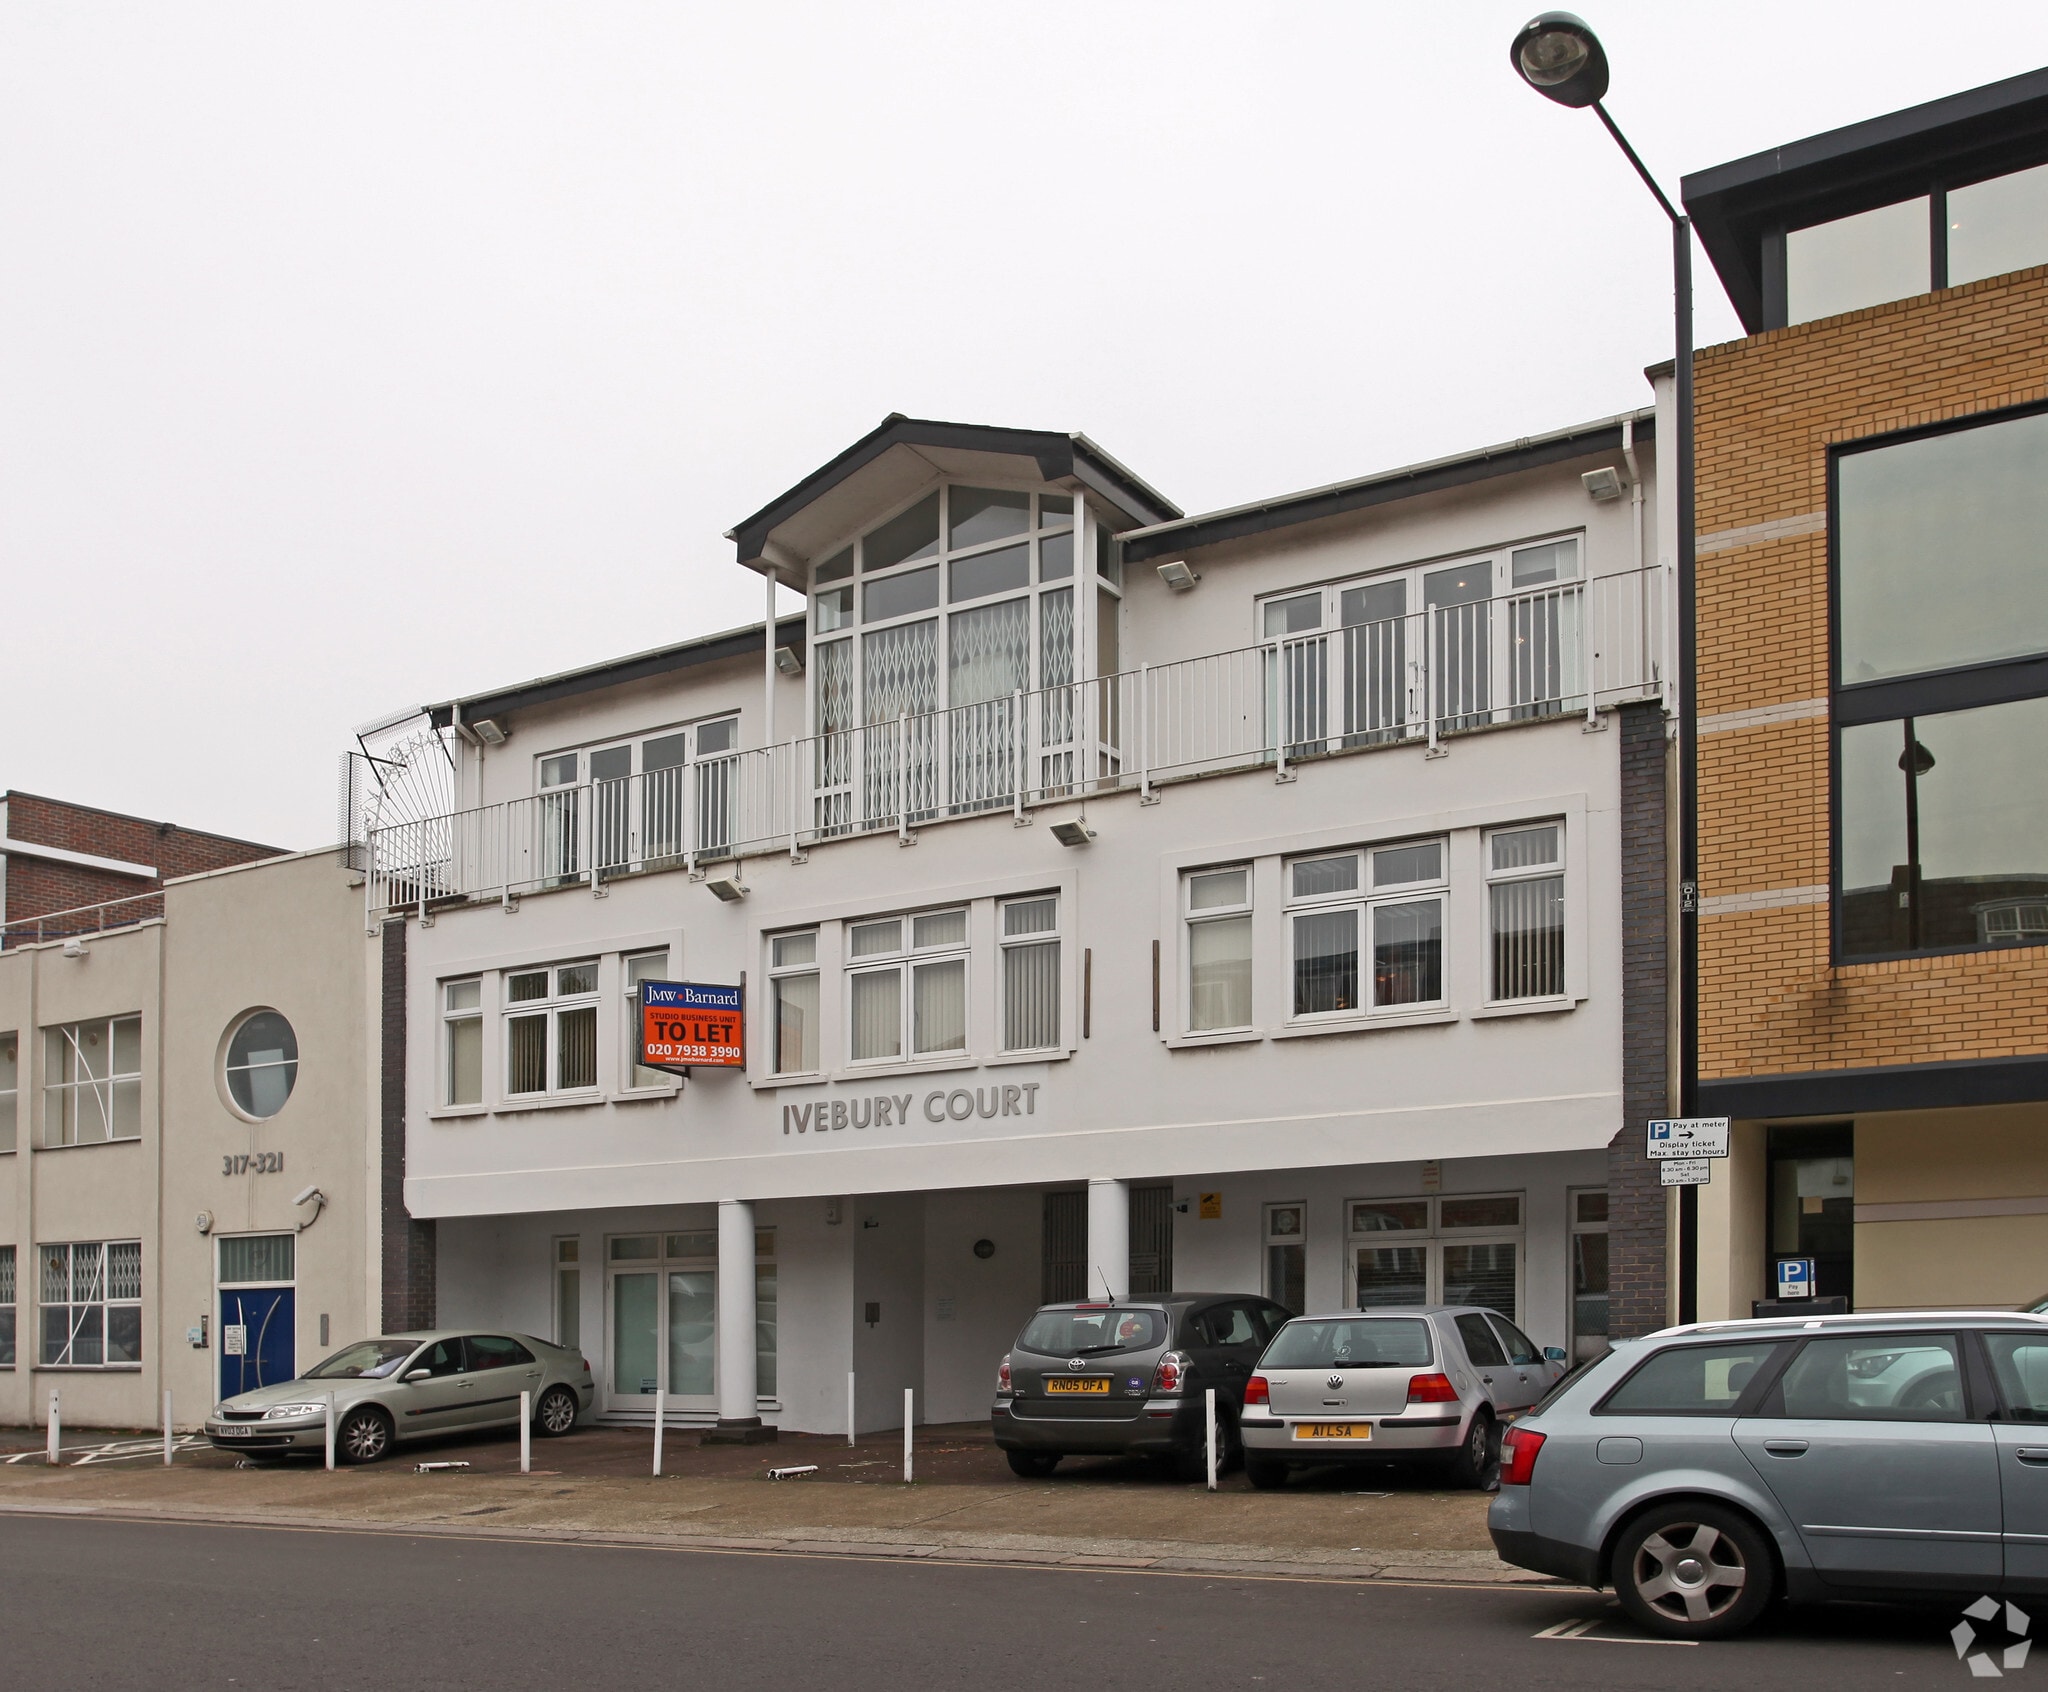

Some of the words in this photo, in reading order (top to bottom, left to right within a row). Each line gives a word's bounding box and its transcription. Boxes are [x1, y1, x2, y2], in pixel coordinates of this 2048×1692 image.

[685, 988, 738, 1005] Barnard
[650, 1012, 679, 1021] STUDIO
[681, 1013, 718, 1022] BUSINESS
[654, 1022, 686, 1041] TO
[695, 1023, 733, 1043] LET
[647, 1043, 672, 1055] 020
[675, 1044, 707, 1057] 7938
[710, 1046, 740, 1058] 3990
[783, 1093, 913, 1135] IVEBURY
[923, 1082, 1040, 1123] COURT
[1654, 1123, 1667, 1139] P
[222, 1151, 283, 1176] 317-321
[1784, 1263, 1801, 1282] P
[1052, 1380, 1080, 1390] RN05
[1082, 1380, 1103, 1390] OFA
